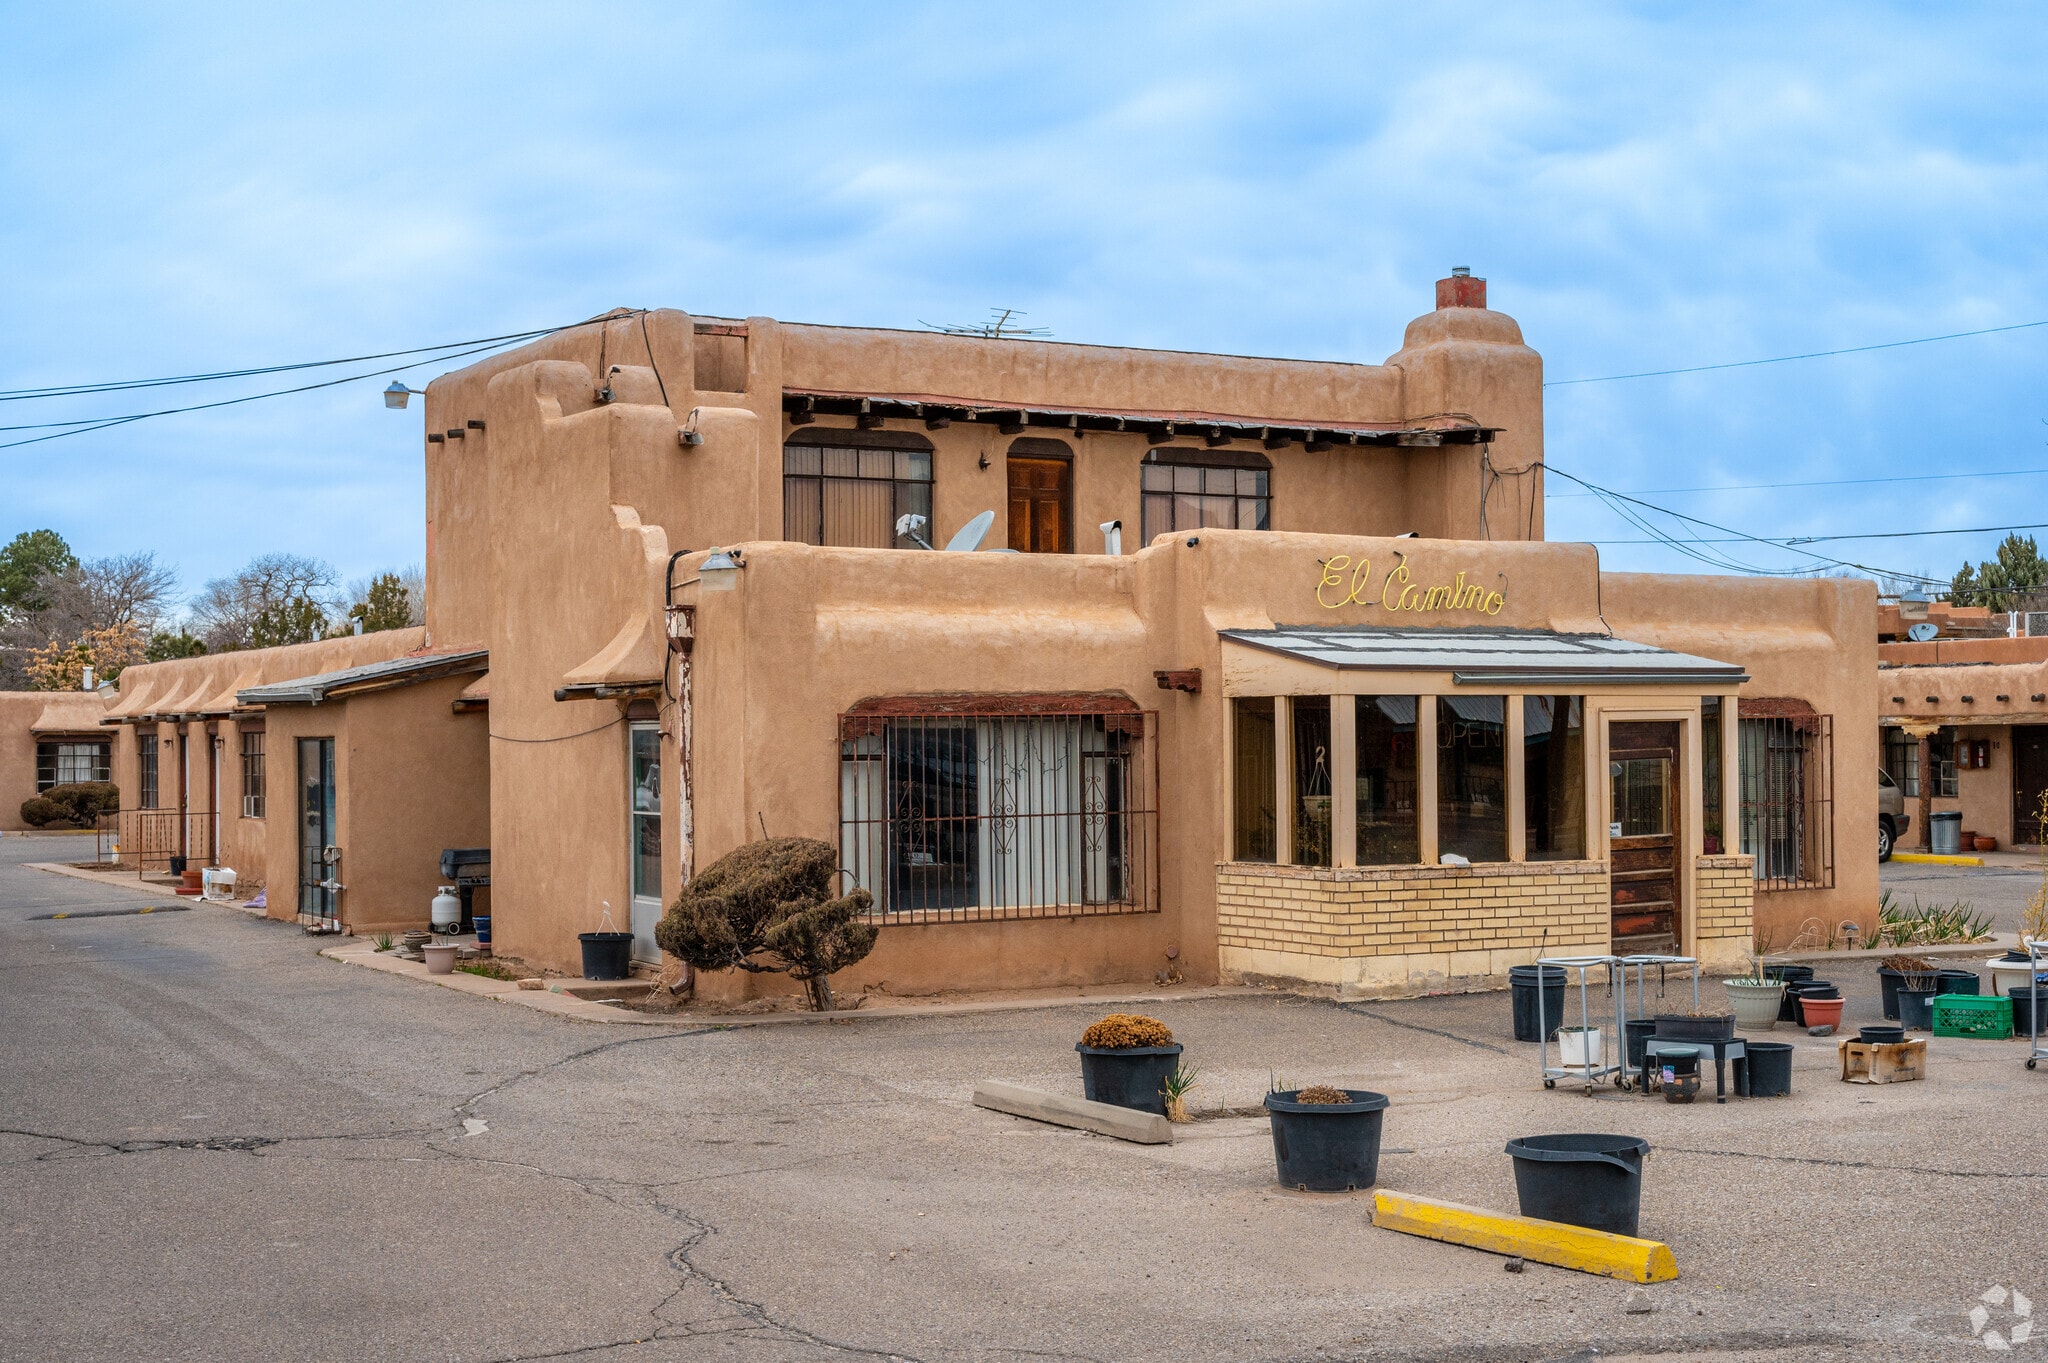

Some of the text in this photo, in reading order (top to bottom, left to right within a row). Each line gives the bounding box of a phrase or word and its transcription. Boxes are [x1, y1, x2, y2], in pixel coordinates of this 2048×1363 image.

[1317, 554, 1505, 615] El Camino
[1437, 721, 1501, 748] OPEN
